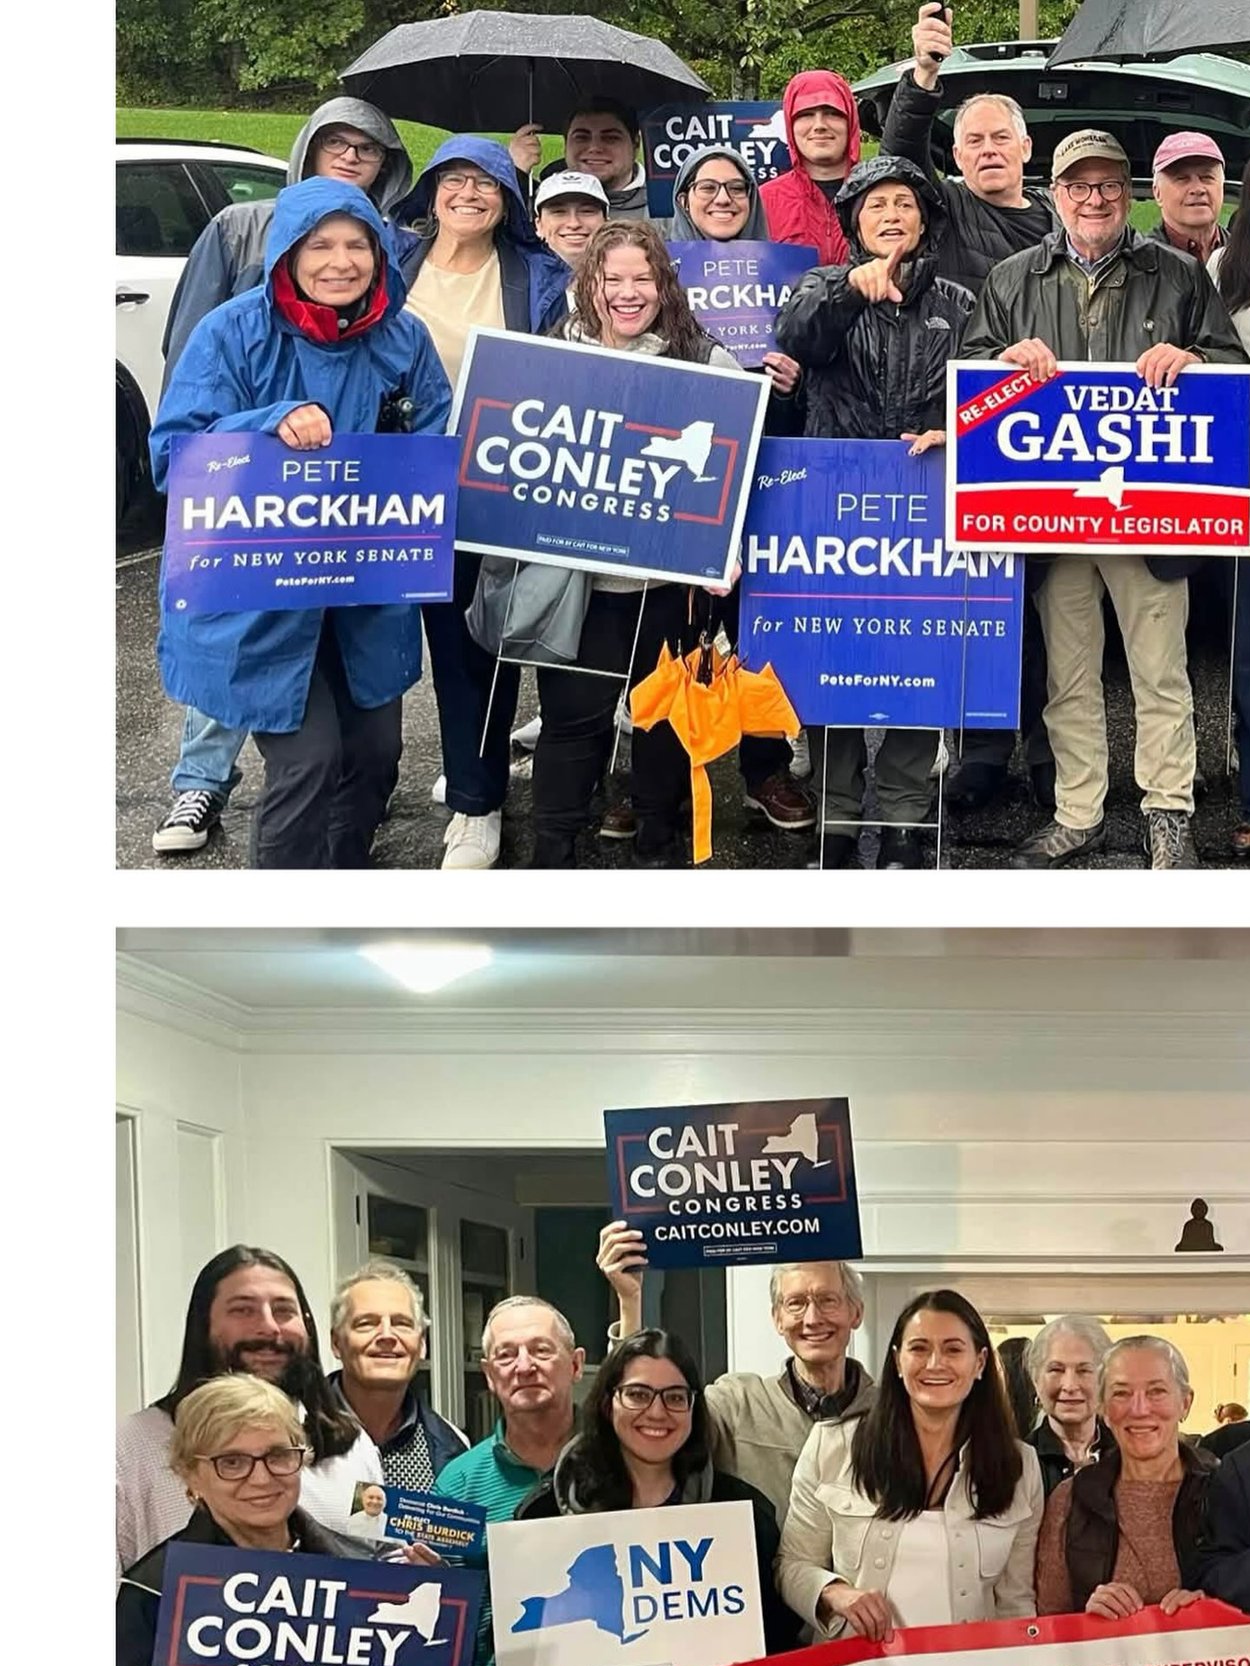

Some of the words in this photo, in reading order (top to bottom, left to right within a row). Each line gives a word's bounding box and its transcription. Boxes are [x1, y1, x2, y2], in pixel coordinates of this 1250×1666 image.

[665, 114, 733, 141] CAIT
[653, 140, 777, 169] COEY
[704, 260, 759, 277] PETE
[687, 284, 791, 311] RCKHA
[718, 325, 759, 336] YORK
[959, 372, 1033, 425] RE-ELECT
[1063, 385, 1179, 412] VEDAT
[511, 399, 624, 448] CAIT
[997, 411, 1214, 464] GASHI
[283, 461, 360, 482] PETE
[476, 436, 682, 500] CONLEY
[758, 467, 807, 490] Re-Elect
[183, 494, 445, 530] HARCKHAM
[512, 482, 671, 522] CONGRESS
[837, 493, 928, 522] PETE
[963, 515, 1006, 532] FOR
[1013, 515, 1103, 533] COUNTY
[1111, 517, 1243, 535] LEGISLATOR
[189, 553, 222, 571] for
[233, 552, 283, 567] NEW
[294, 551, 347, 565] YORK
[355, 548, 434, 563] SENATE
[747, 534, 1014, 578] HARCKHAM
[275, 575, 355, 587] PeteForNY.com
[753, 616, 783, 635] for
[794, 617, 843, 634] NEW
[853, 618, 911, 635] YORK
[922, 620, 1006, 636] SENATE
[820, 674, 935, 687] PeteForNY.com
[648, 1124, 739, 1159] CAIT
[630, 1158, 799, 1198] CONLEY
[669, 1193, 802, 1215] CONGRESS
[655, 1218, 820, 1241] CAITCONLEY.COM
[389, 1517, 423, 1531] CHRIS
[427, 1524, 475, 1541] BURDICK
[629, 1537, 714, 1588] NY
[223, 1573, 347, 1619] CAIT
[633, 1585, 745, 1624] DEMS
[187, 1616, 411, 1666] CONLEY
